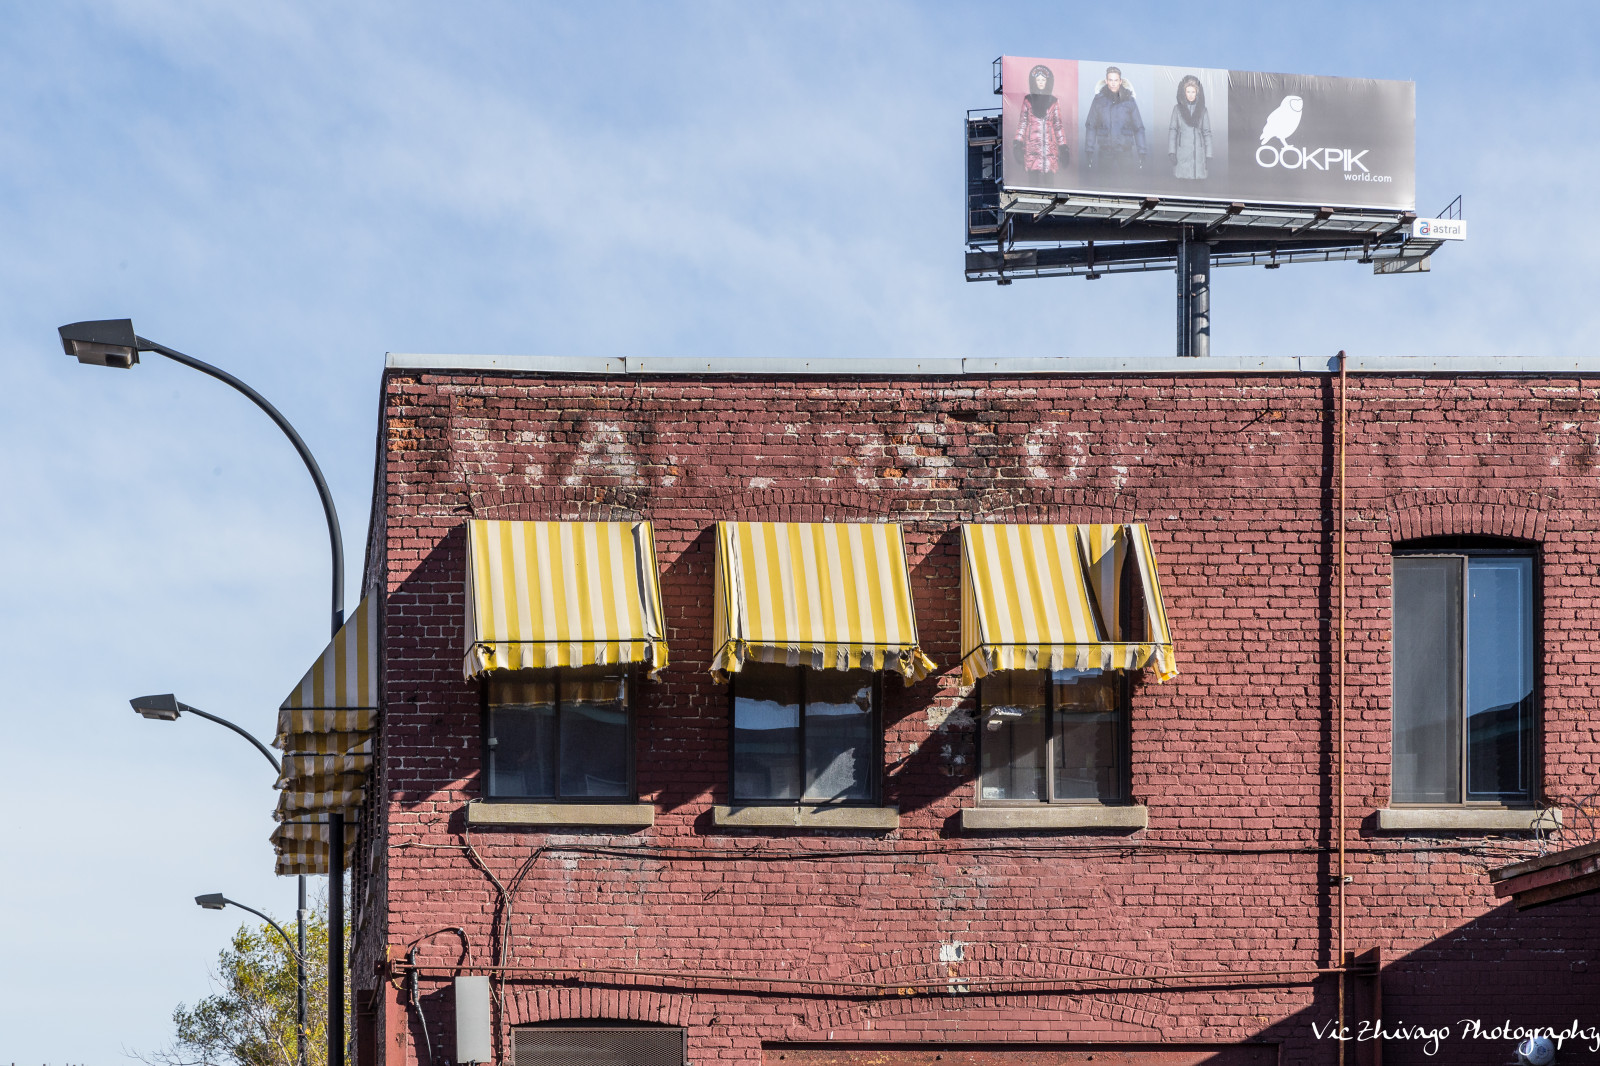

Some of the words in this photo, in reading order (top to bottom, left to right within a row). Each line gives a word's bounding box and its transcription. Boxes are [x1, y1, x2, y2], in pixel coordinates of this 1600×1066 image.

[1255, 145, 1370, 173] OOKPIK
[1344, 173, 1392, 183] world.com
[1433, 225, 1461, 235] astral
